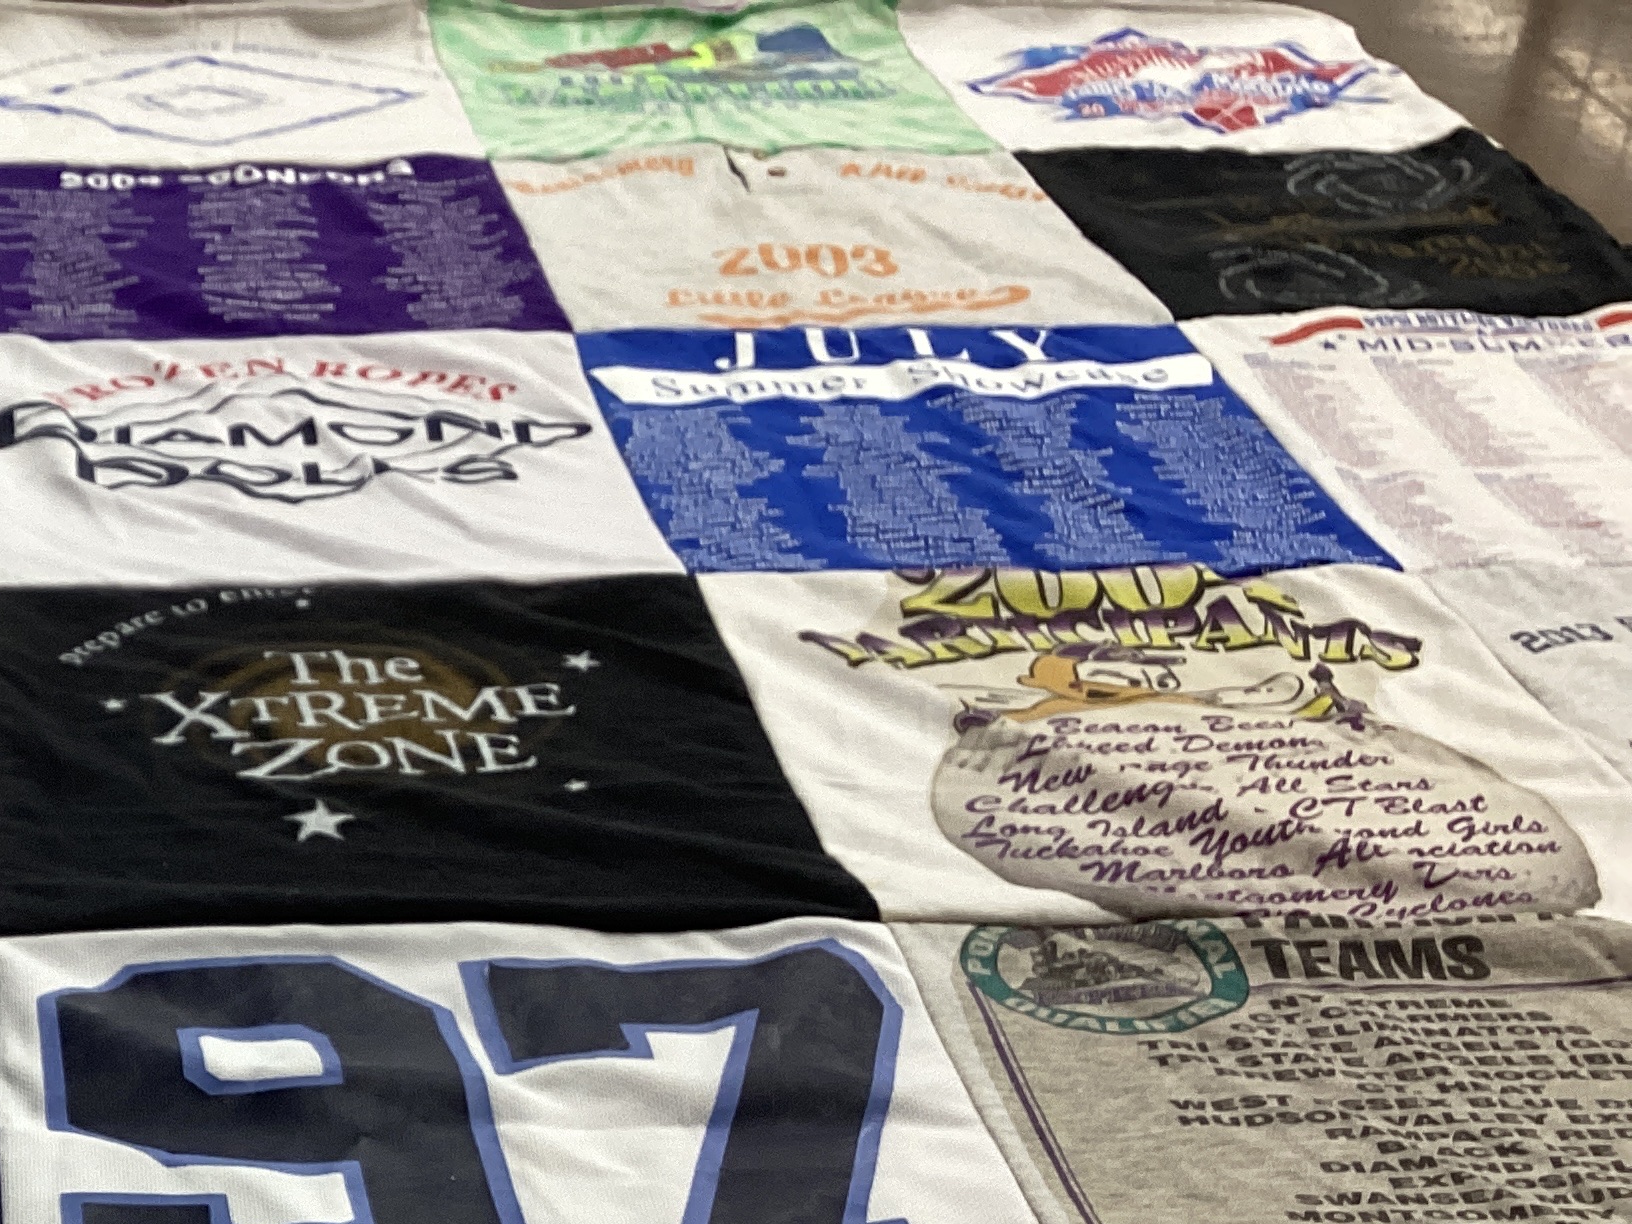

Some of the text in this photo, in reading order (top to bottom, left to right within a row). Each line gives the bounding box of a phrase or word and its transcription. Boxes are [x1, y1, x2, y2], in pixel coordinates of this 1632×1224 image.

[713, 243, 900, 278] 2003
[715, 328, 1054, 370] JULY
[313, 358, 521, 402] ROPES
[652, 358, 1170, 400] Summer Showcase
[264, 649, 424, 685] The
[139, 682, 578, 744] XTREME
[231, 729, 537, 780] ZONE
[1226, 750, 1395, 773] Thunder
[997, 761, 1097, 794] New
[965, 780, 1183, 815] Challeng
[960, 814, 1070, 841] Long
[1446, 814, 1550, 842] Girls
[1249, 934, 1492, 981] TEAMS
[1169, 1094, 1293, 1113] WEST
[1381, 1111, 1549, 1128] VALLEY
[1319, 1155, 1535, 1174] DIAMND
